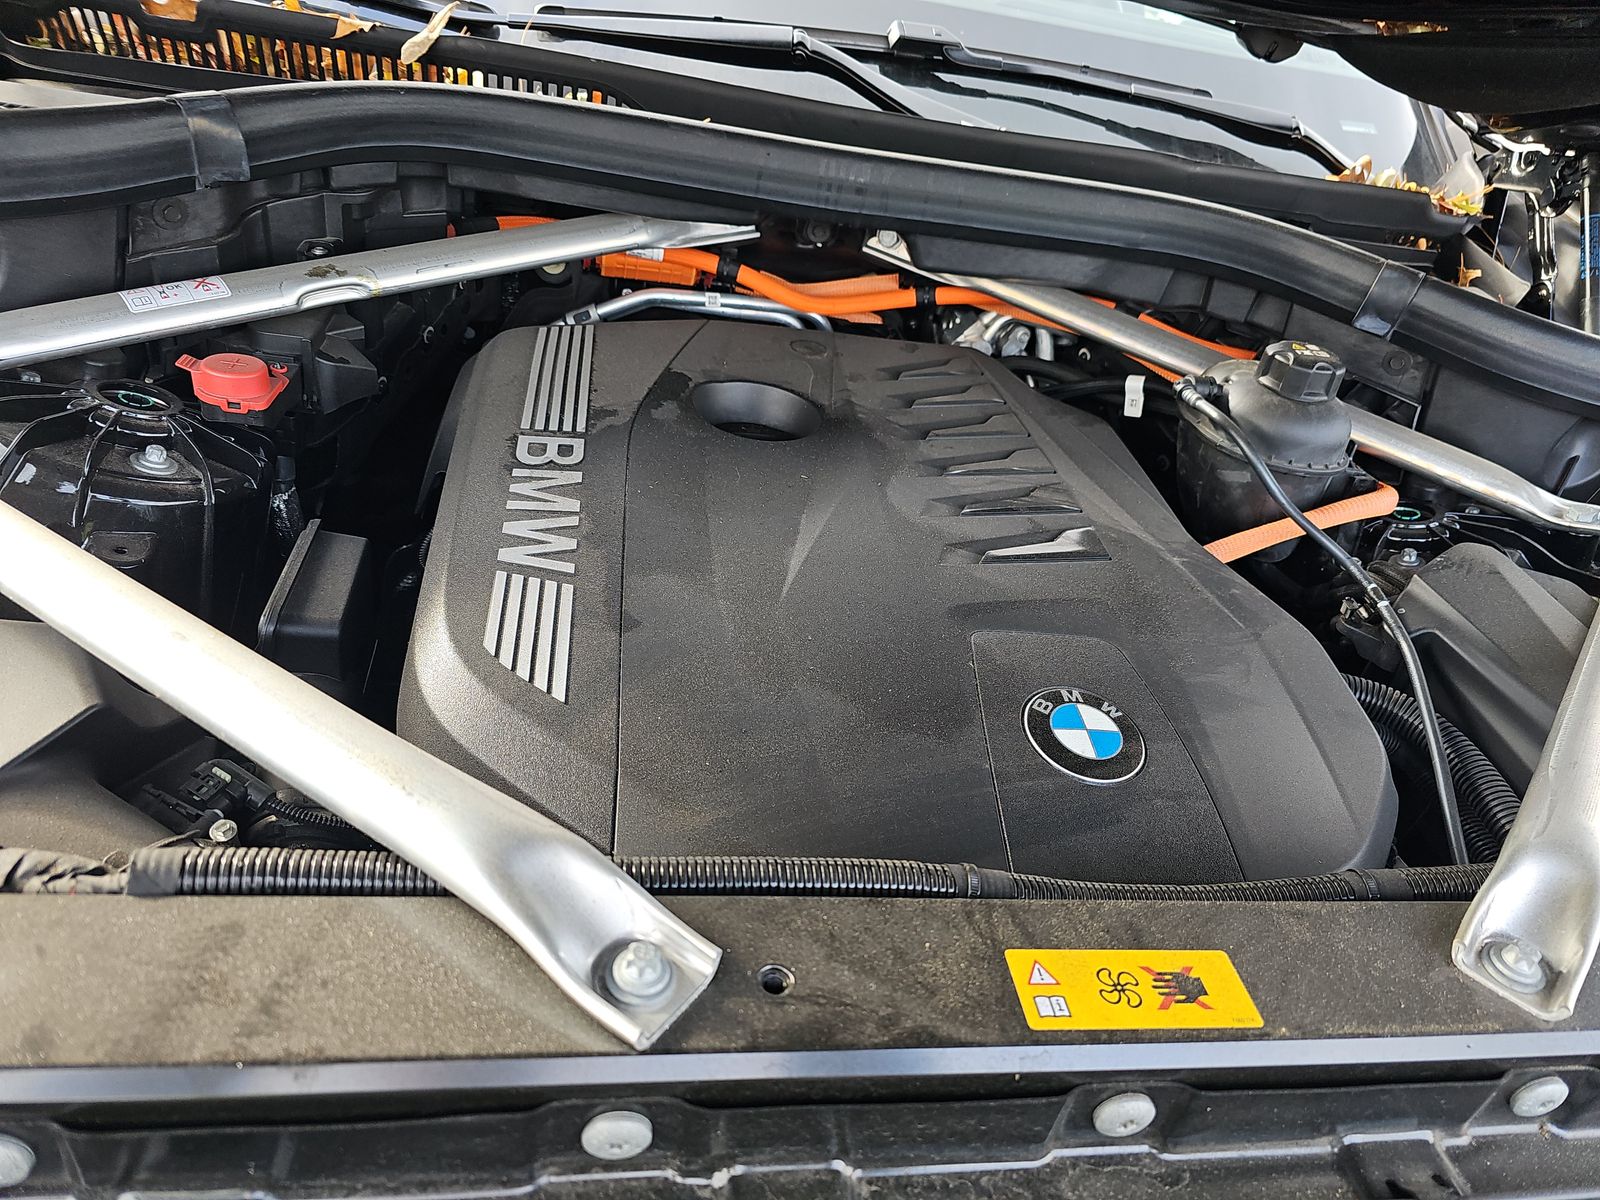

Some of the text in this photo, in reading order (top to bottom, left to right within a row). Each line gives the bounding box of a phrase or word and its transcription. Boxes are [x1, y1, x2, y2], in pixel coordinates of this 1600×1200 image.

[166, 283, 183, 291] OK
[497, 435, 585, 574] BMW
[1032, 689, 1122, 719] BMW
